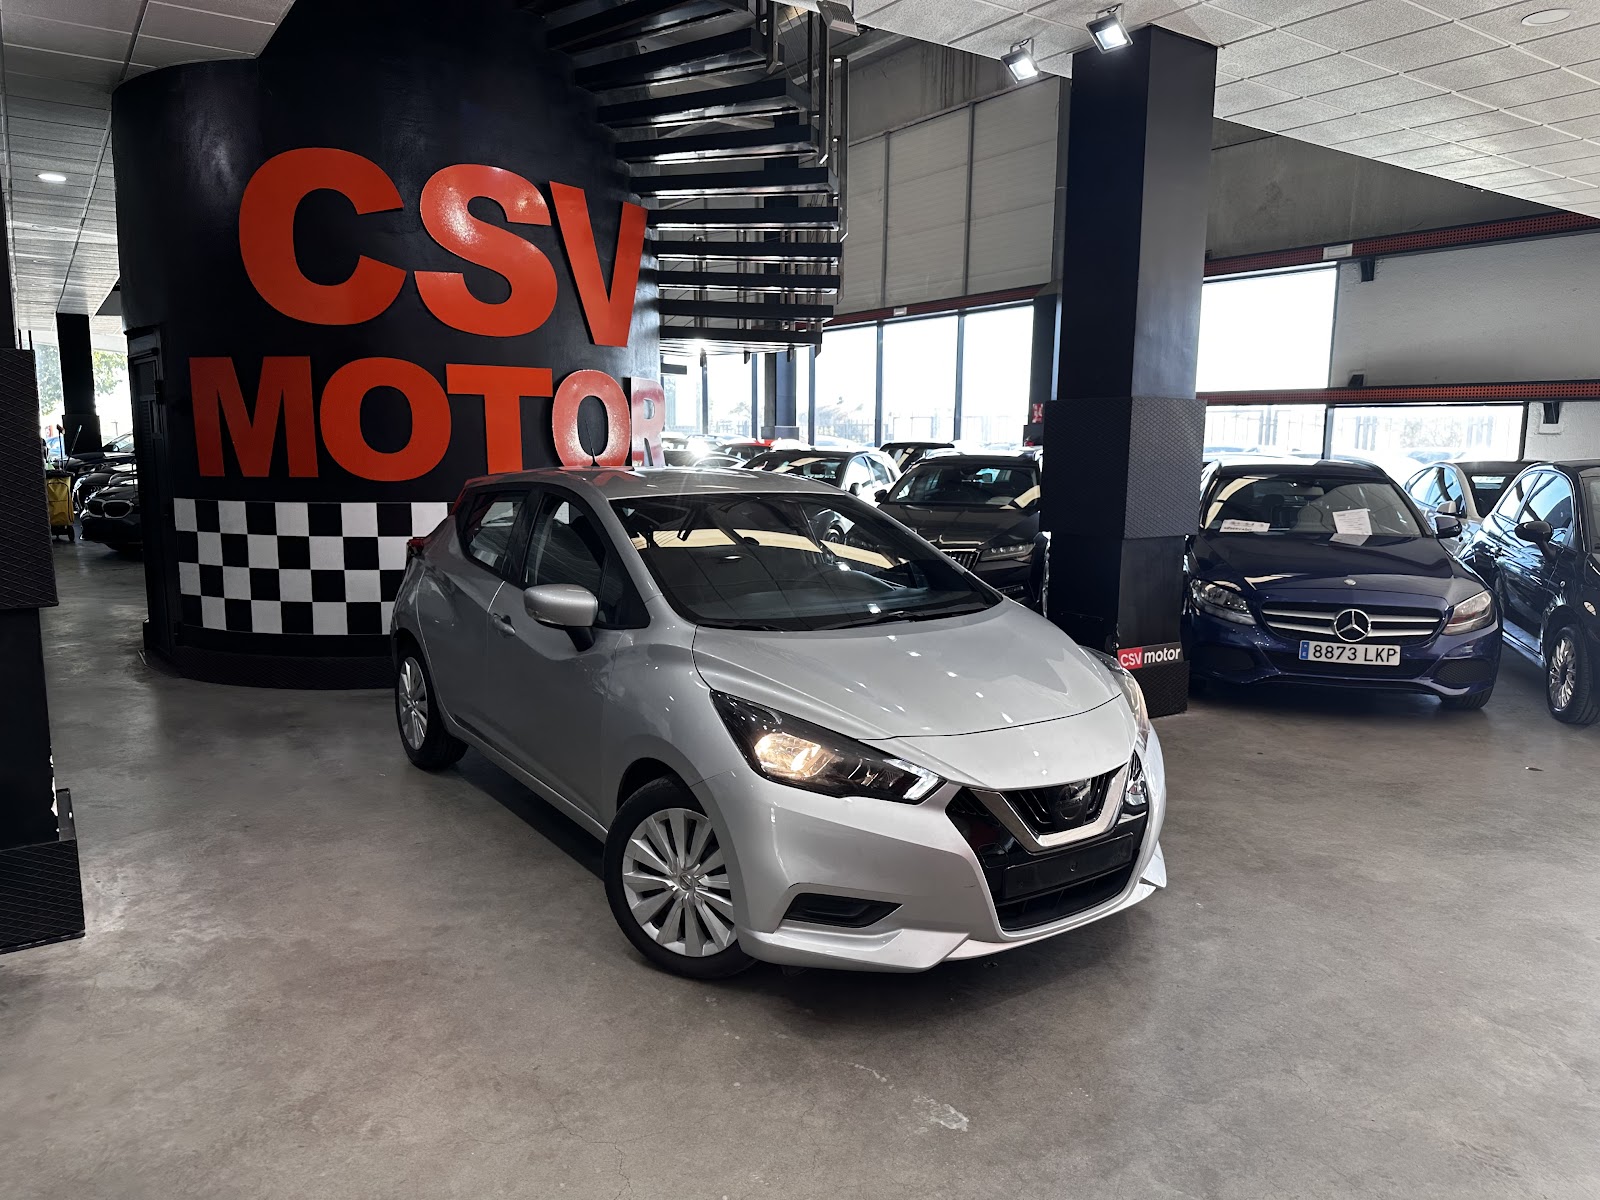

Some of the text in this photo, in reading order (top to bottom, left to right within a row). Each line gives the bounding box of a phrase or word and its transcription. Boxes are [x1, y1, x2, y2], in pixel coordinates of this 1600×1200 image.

[238, 147, 648, 347] CSV
[189, 356, 664, 481] MOTOR
[1120, 647, 1181, 667] CSV motor
[1313, 644, 1357, 661] 8873
[1364, 647, 1397, 663] LKP
